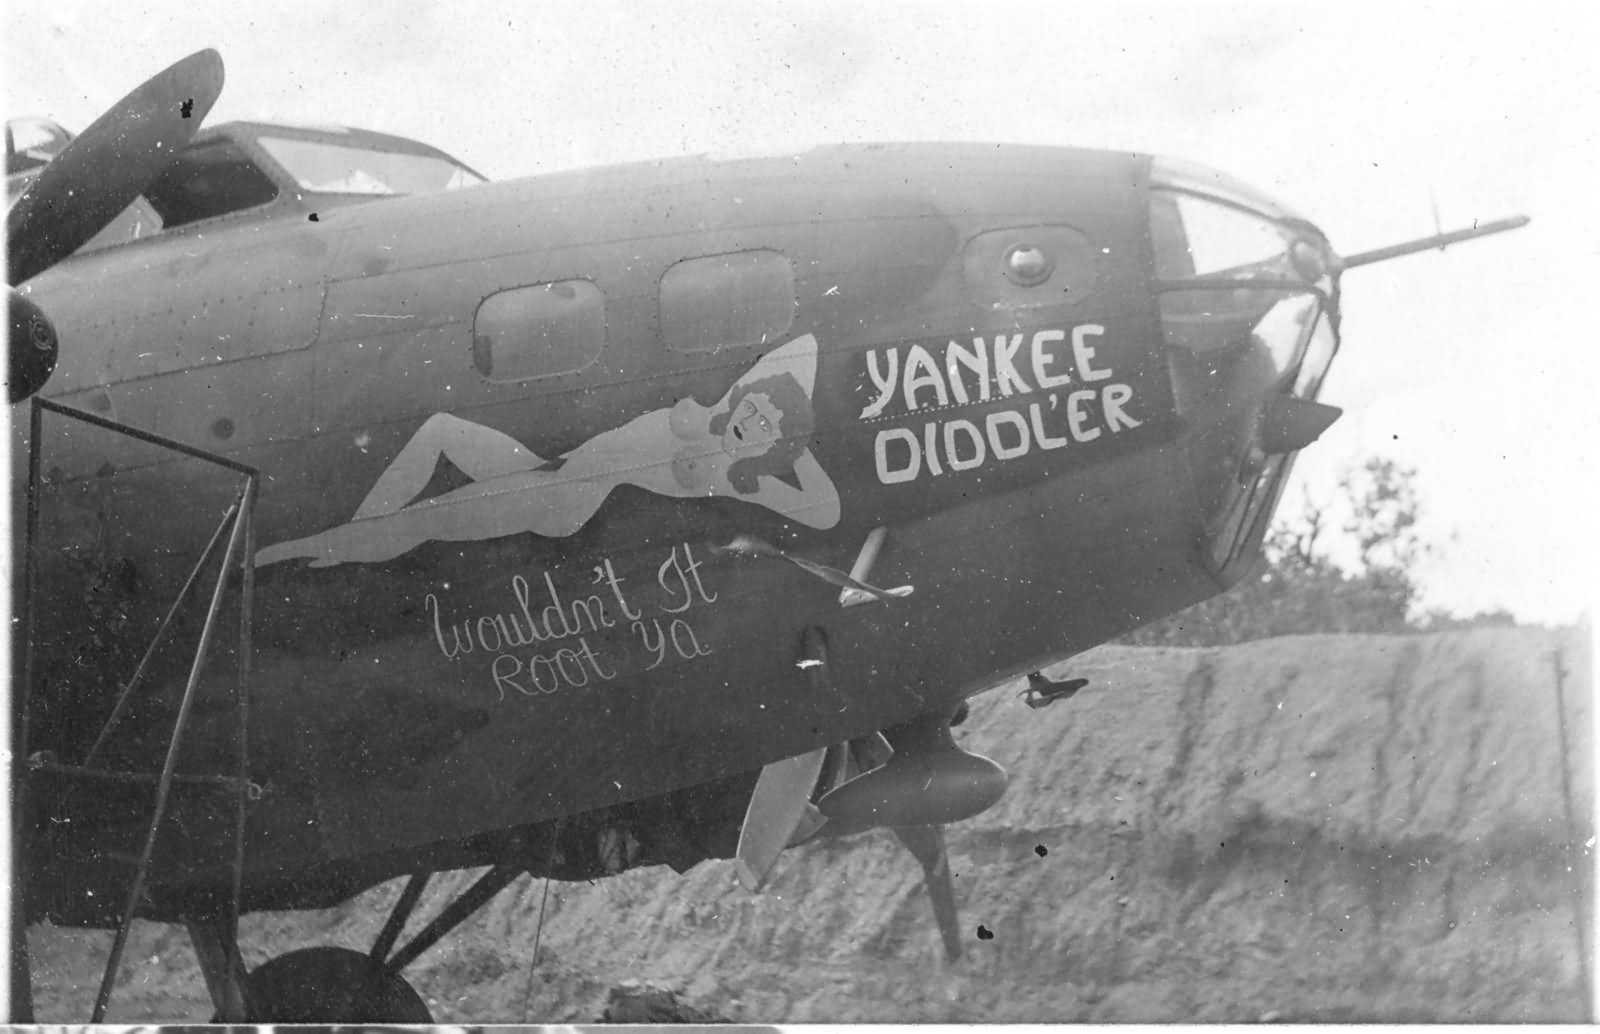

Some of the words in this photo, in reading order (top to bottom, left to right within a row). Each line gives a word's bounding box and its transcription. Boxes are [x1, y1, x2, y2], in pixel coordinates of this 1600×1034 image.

[858, 323, 1113, 420] YANKEE
[874, 383, 1143, 485] DIDDL'ER
[424, 558, 642, 658] Wouldn't
[657, 542, 718, 613] It
